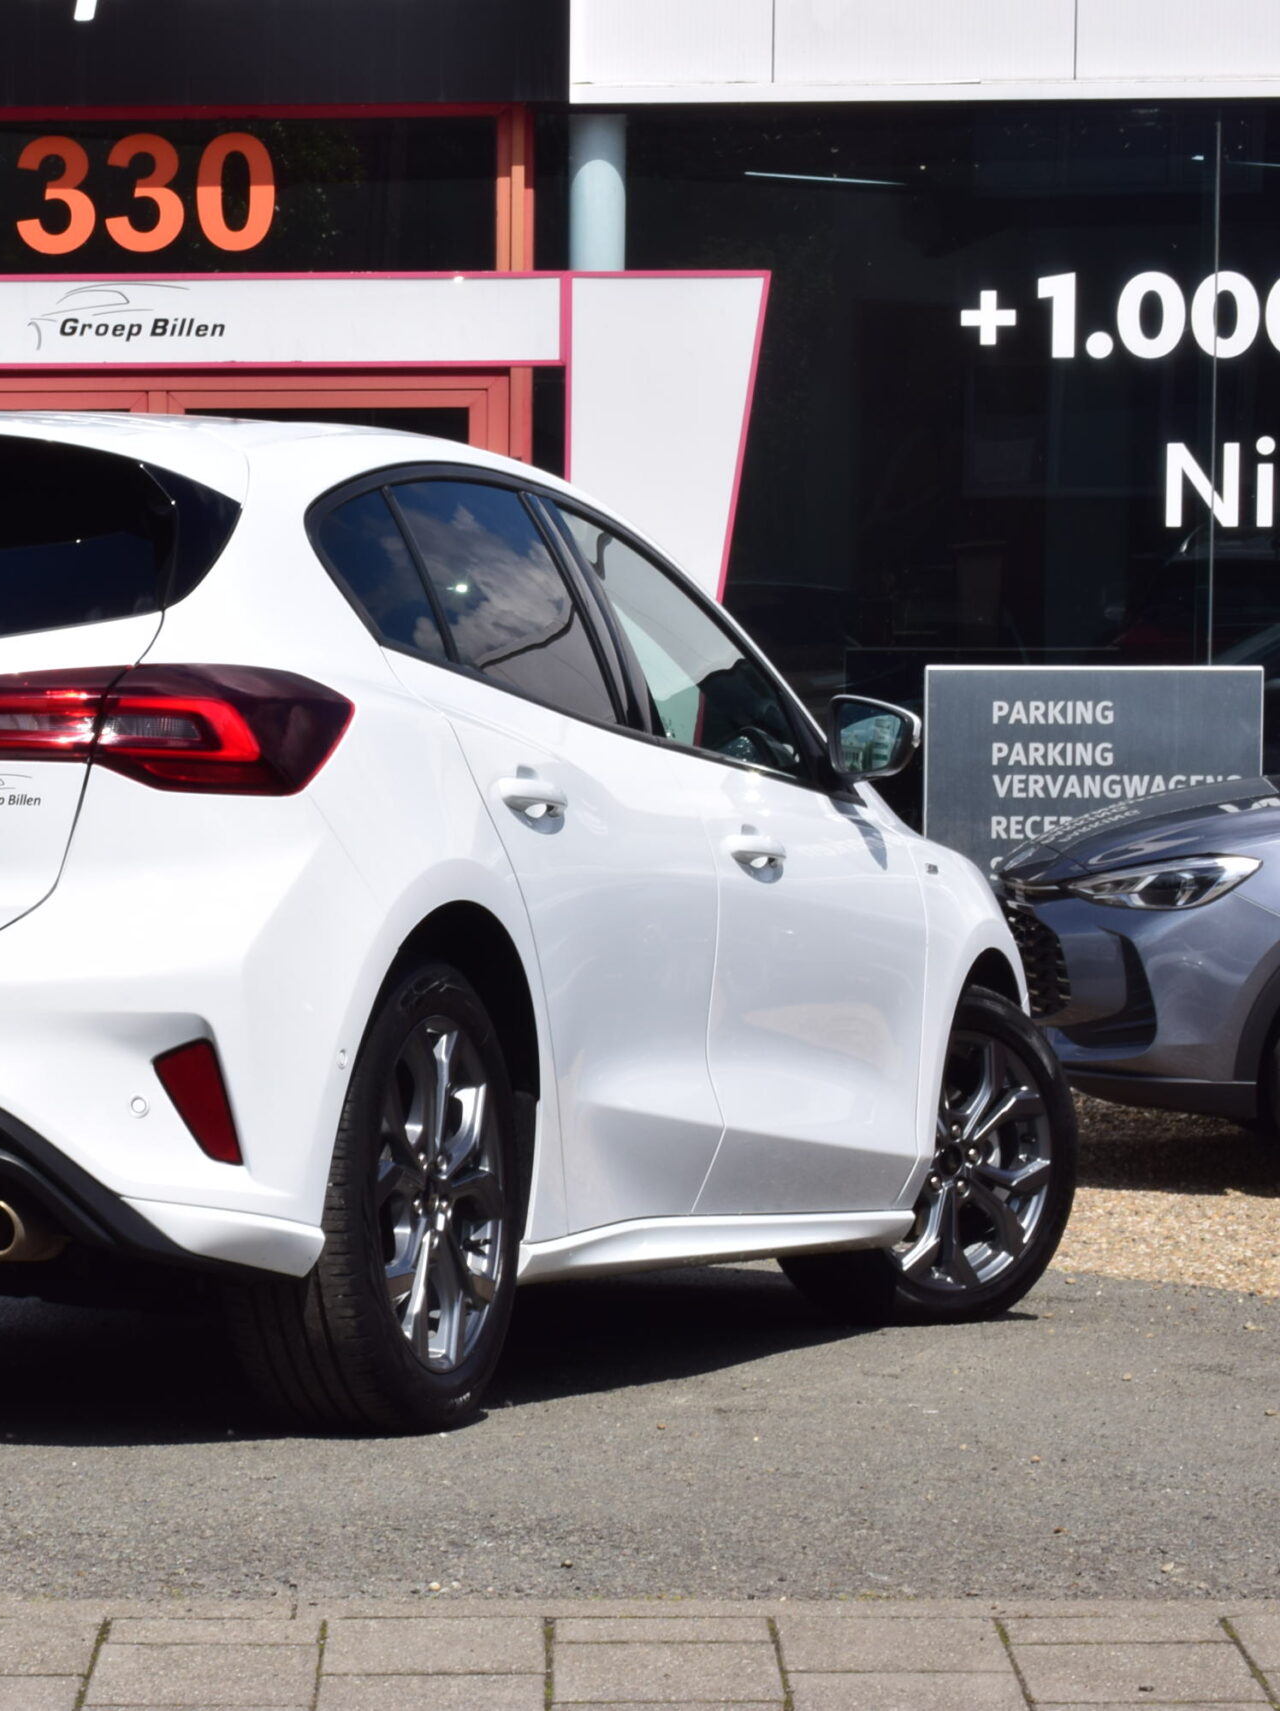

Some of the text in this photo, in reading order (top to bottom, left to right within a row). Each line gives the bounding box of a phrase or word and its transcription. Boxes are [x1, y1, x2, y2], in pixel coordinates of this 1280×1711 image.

[16, 132, 276, 255] 330
[59, 317, 226, 342] Groep Billen
[991, 700, 1115, 725] PARKING
[991, 742, 1114, 767] PARKING
[8, 793, 42, 806] Billen
